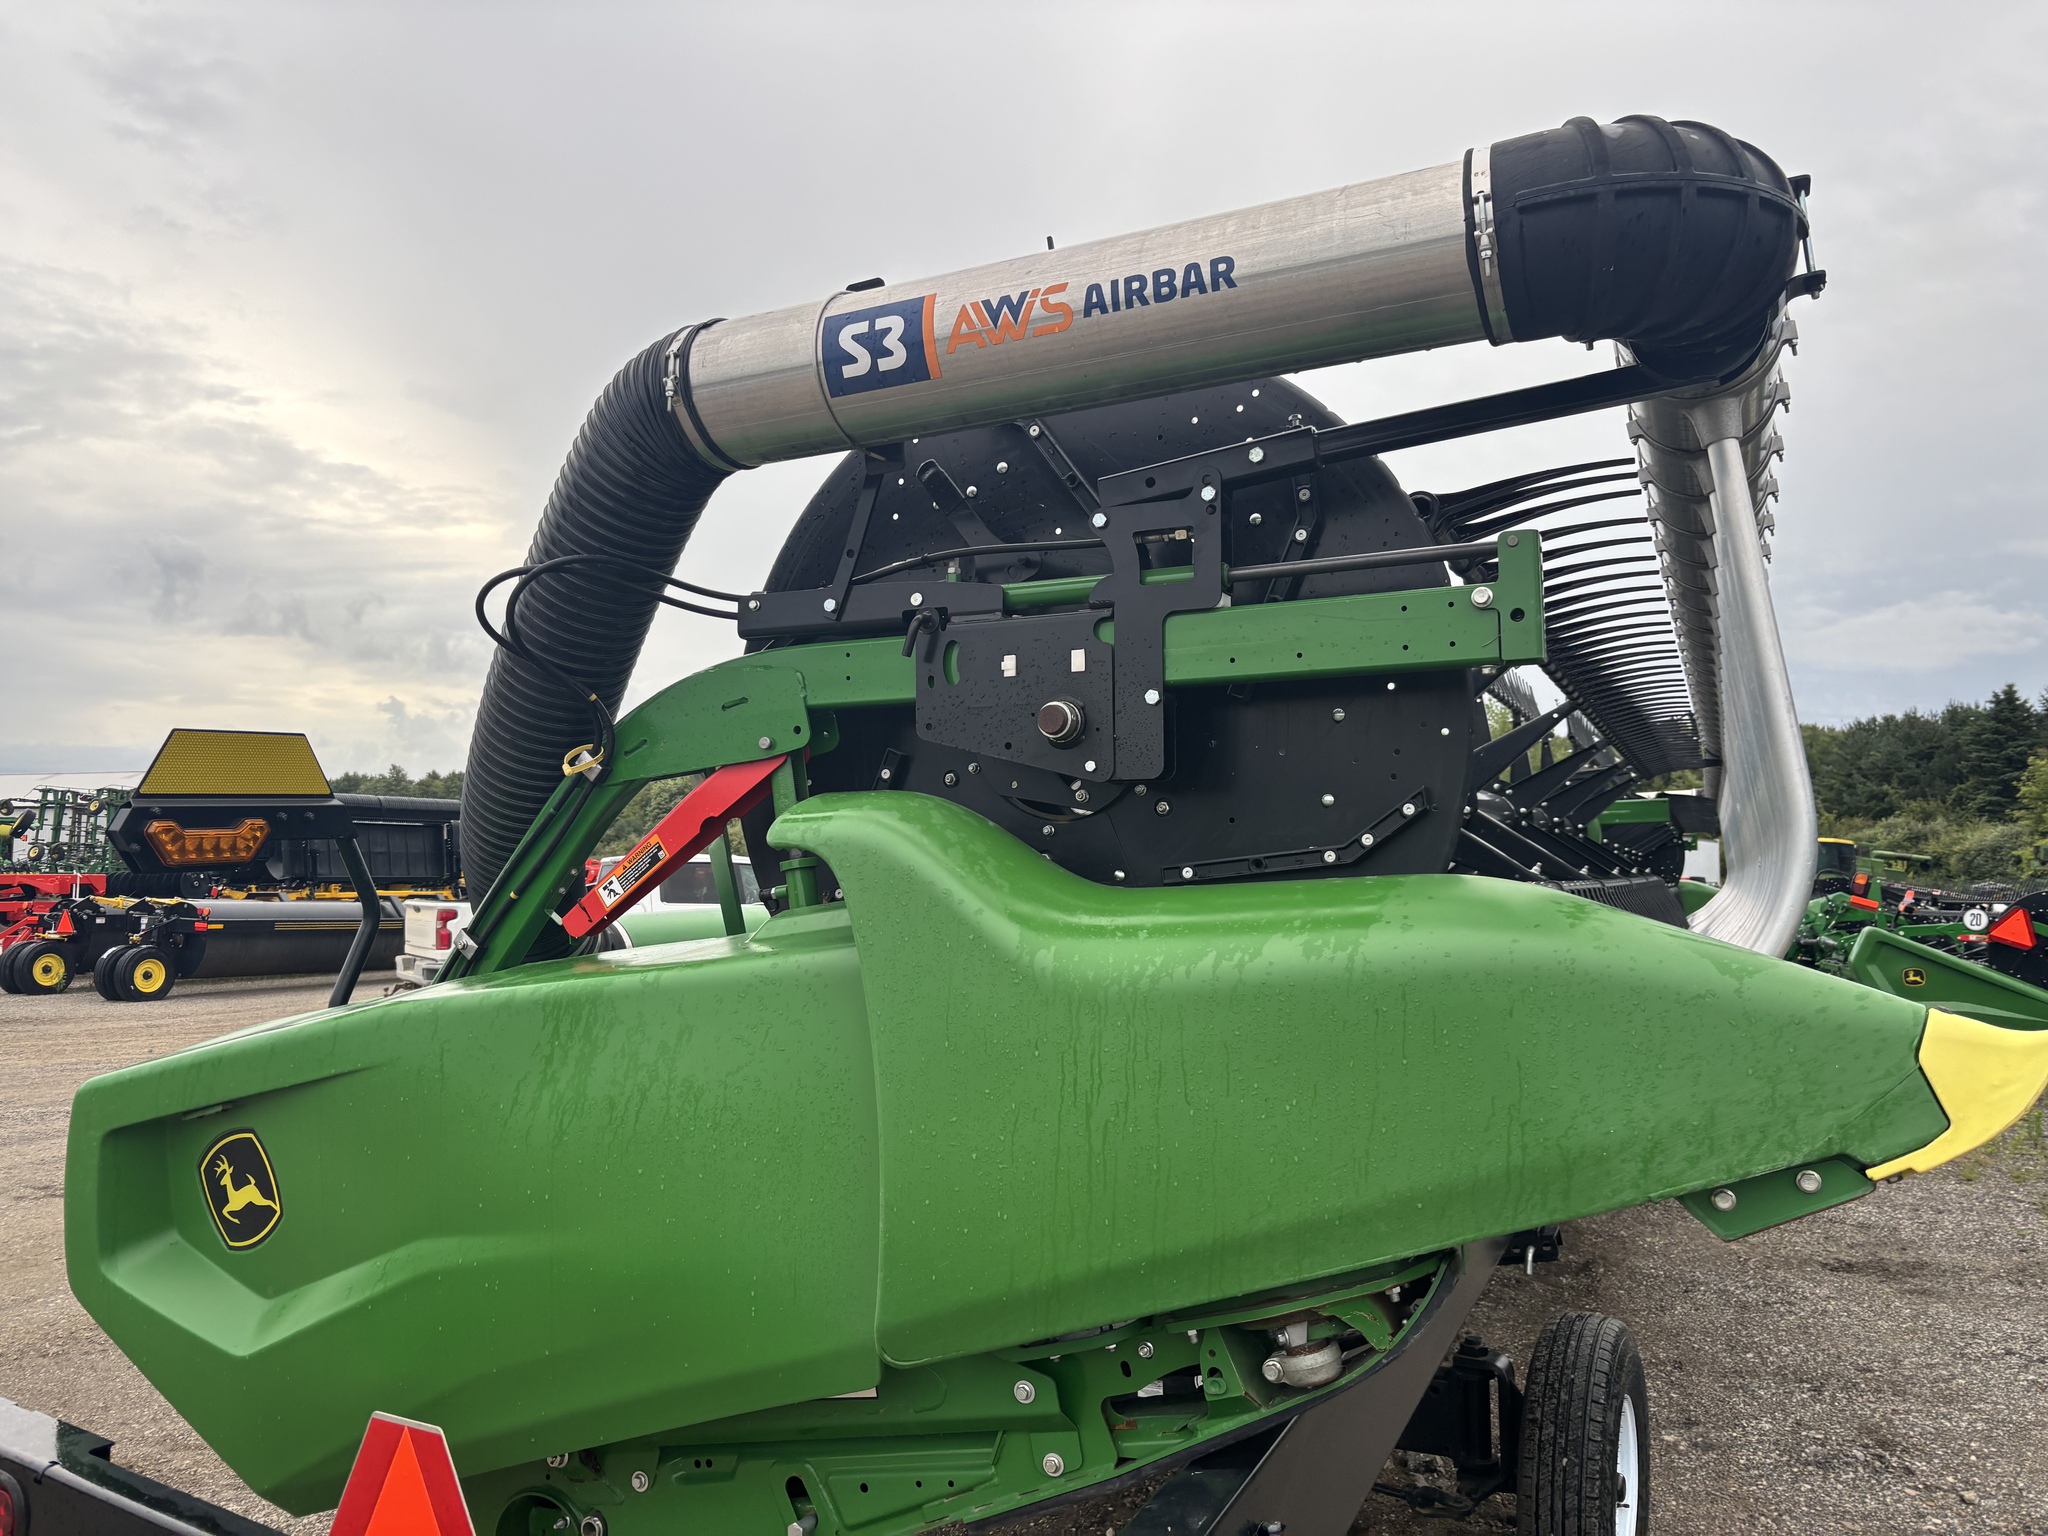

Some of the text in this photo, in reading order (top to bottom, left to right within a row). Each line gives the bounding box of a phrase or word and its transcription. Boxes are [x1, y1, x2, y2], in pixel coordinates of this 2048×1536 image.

[838, 255, 1238, 379] S3 AWS AIRBAR
[626, 841, 652, 865] WARNING
[1970, 913, 1981, 926] 20
